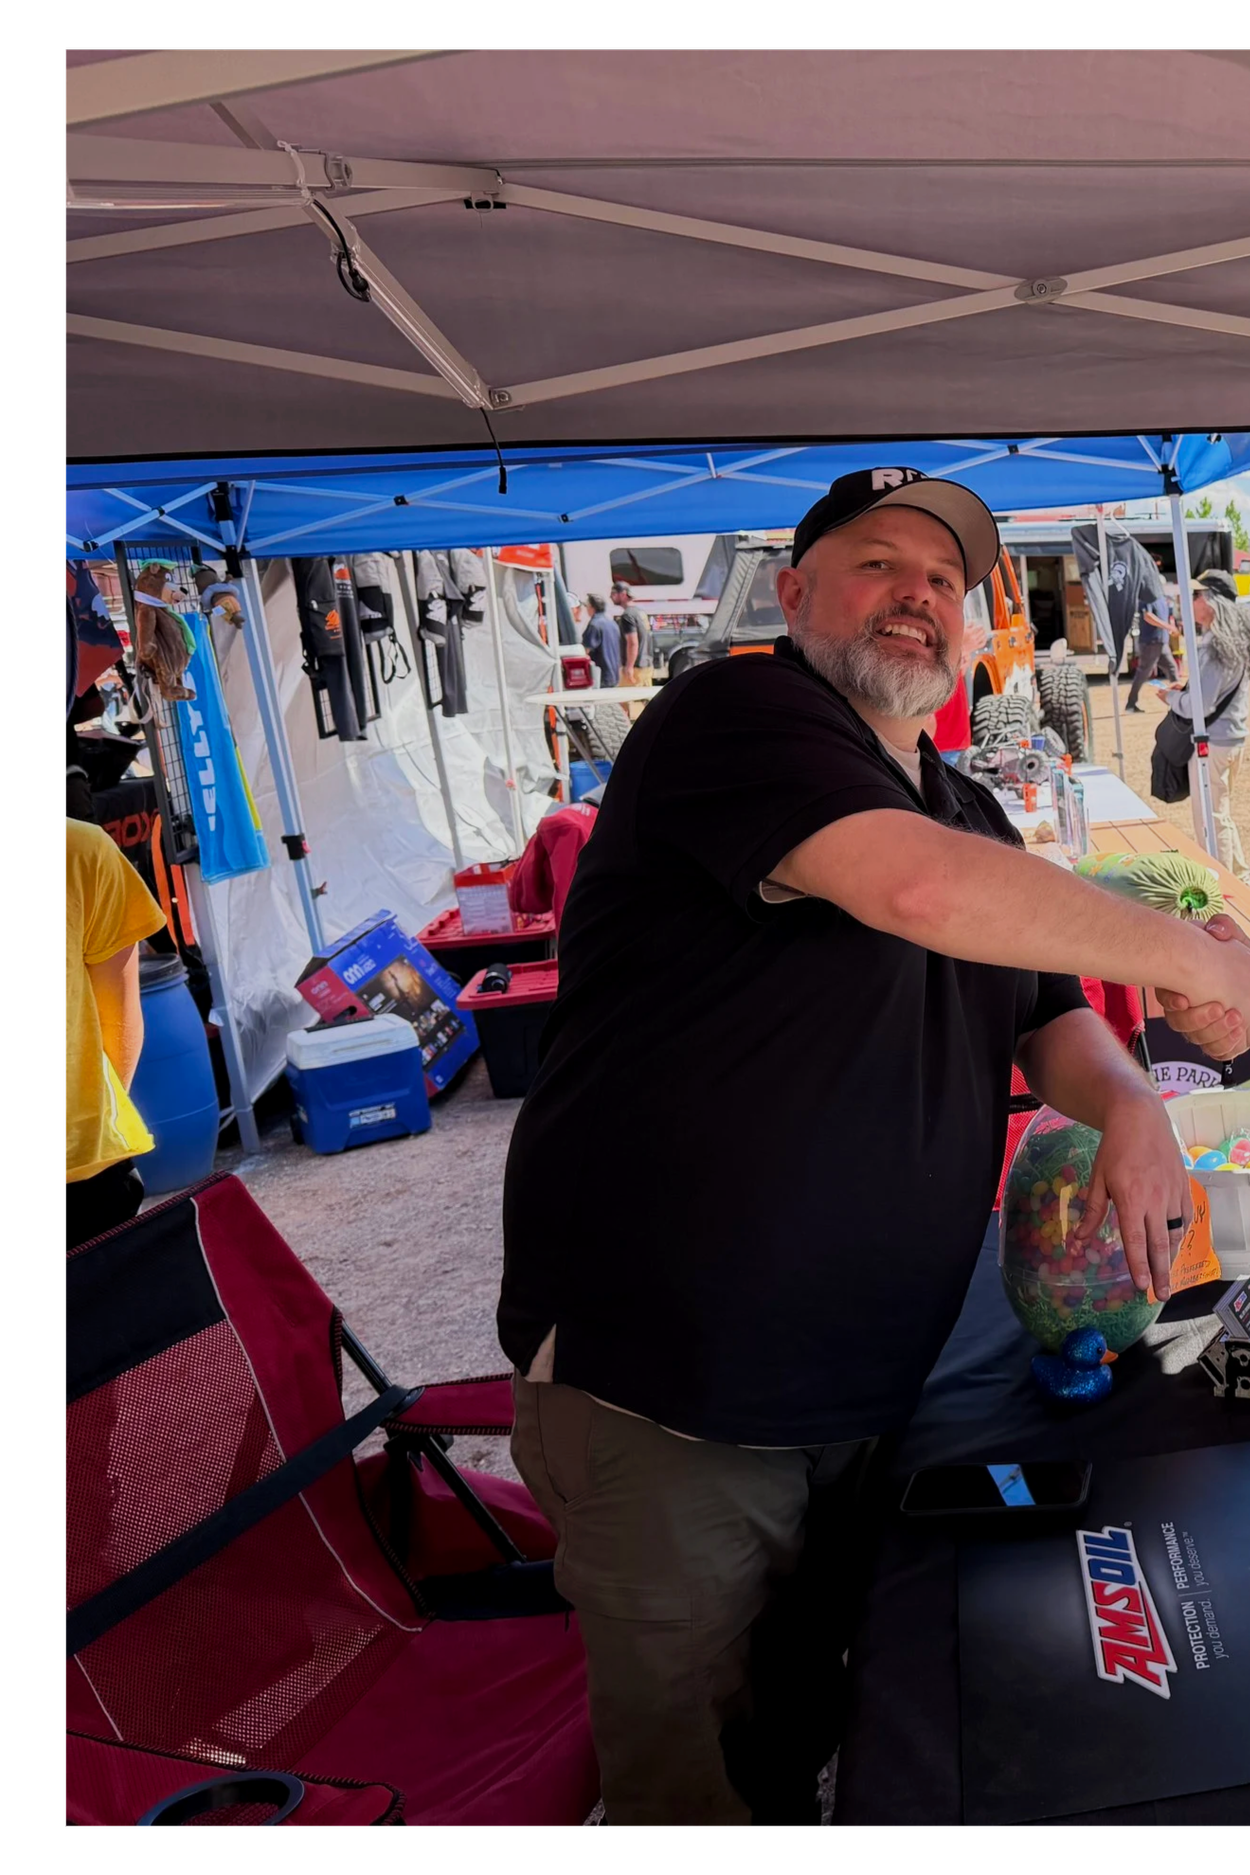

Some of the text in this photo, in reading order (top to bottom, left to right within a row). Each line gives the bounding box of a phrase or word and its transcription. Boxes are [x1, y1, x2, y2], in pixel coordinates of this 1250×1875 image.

[1080, 1527, 1172, 1692] AMSOIL
[1161, 1521, 1210, 1669] PROTECTION PERFORMANCE
[1194, 1570, 1209, 1587] you
[1212, 1642, 1229, 1659] you
